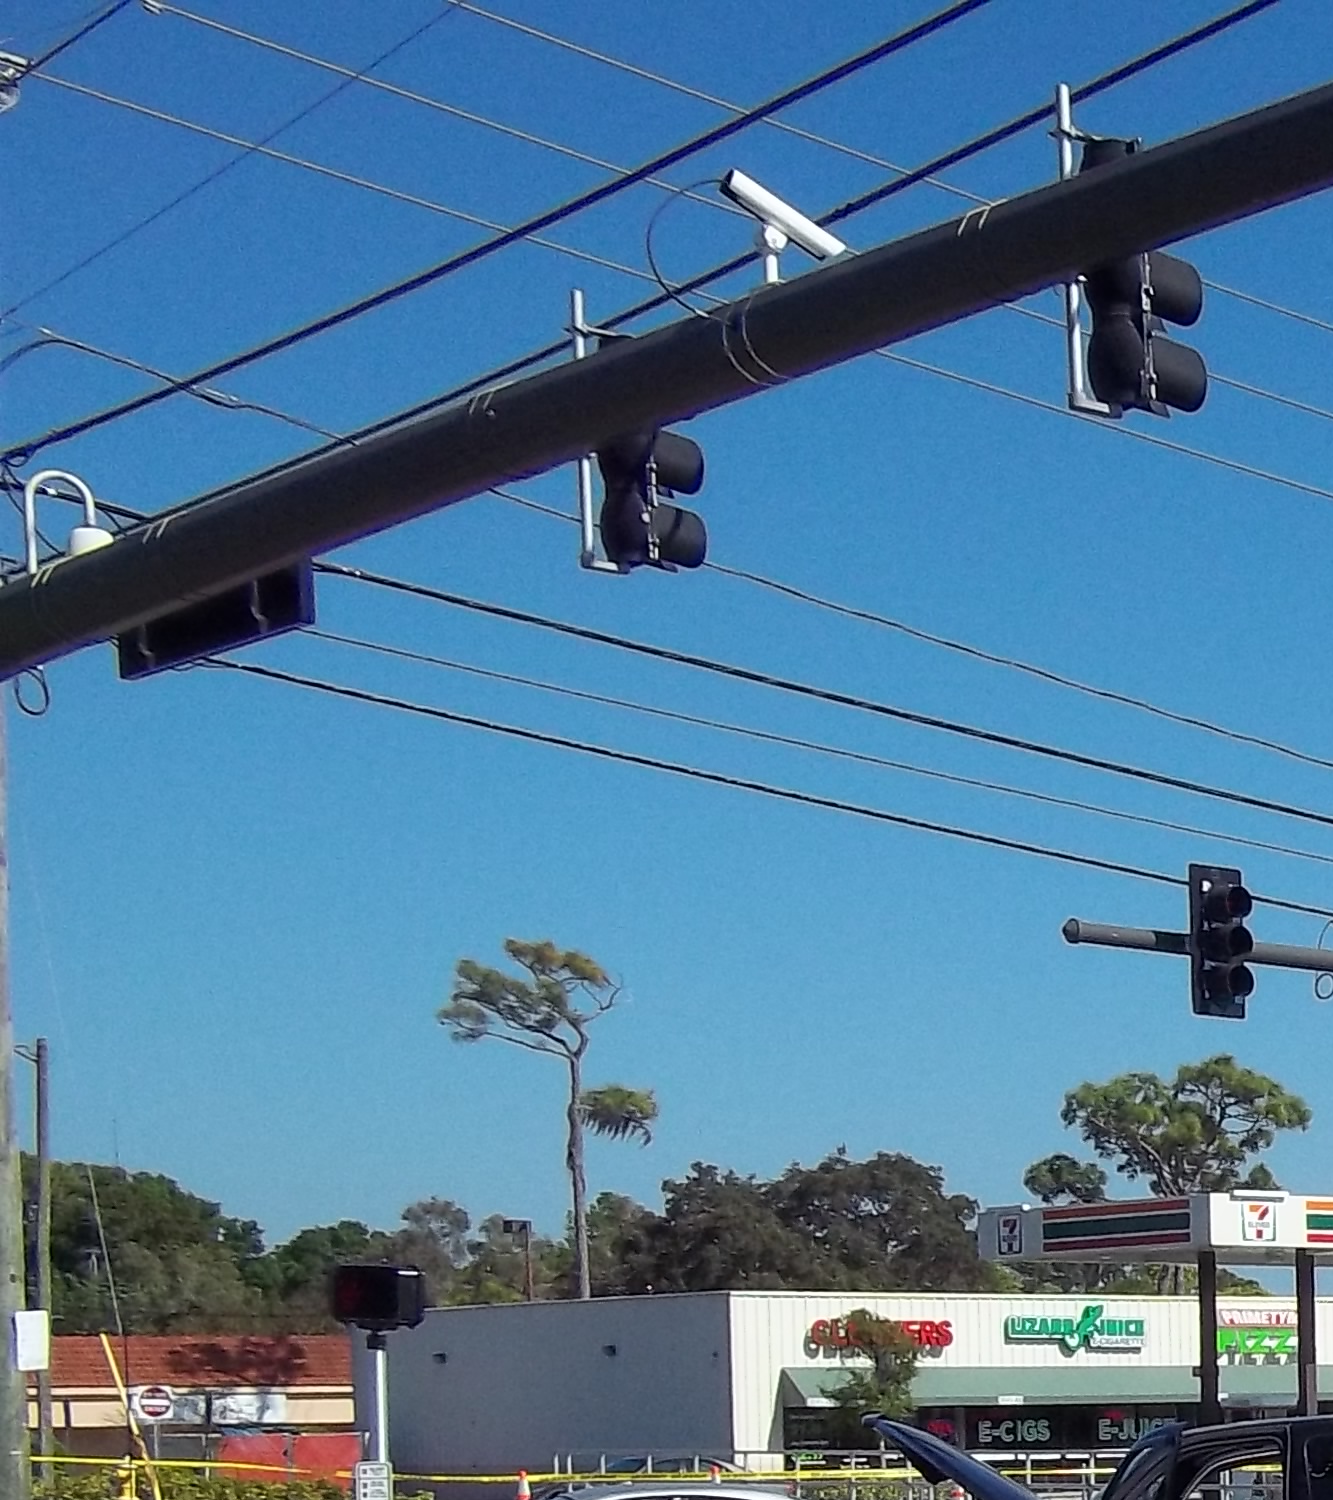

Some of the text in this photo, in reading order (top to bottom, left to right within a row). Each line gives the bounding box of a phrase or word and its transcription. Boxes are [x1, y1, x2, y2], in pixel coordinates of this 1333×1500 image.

[1010, 1317, 1145, 1337] LIZARD JUICE
[1217, 1330, 1297, 1353] PIZZ
[977, 1419, 1051, 1443] E-CIGS
